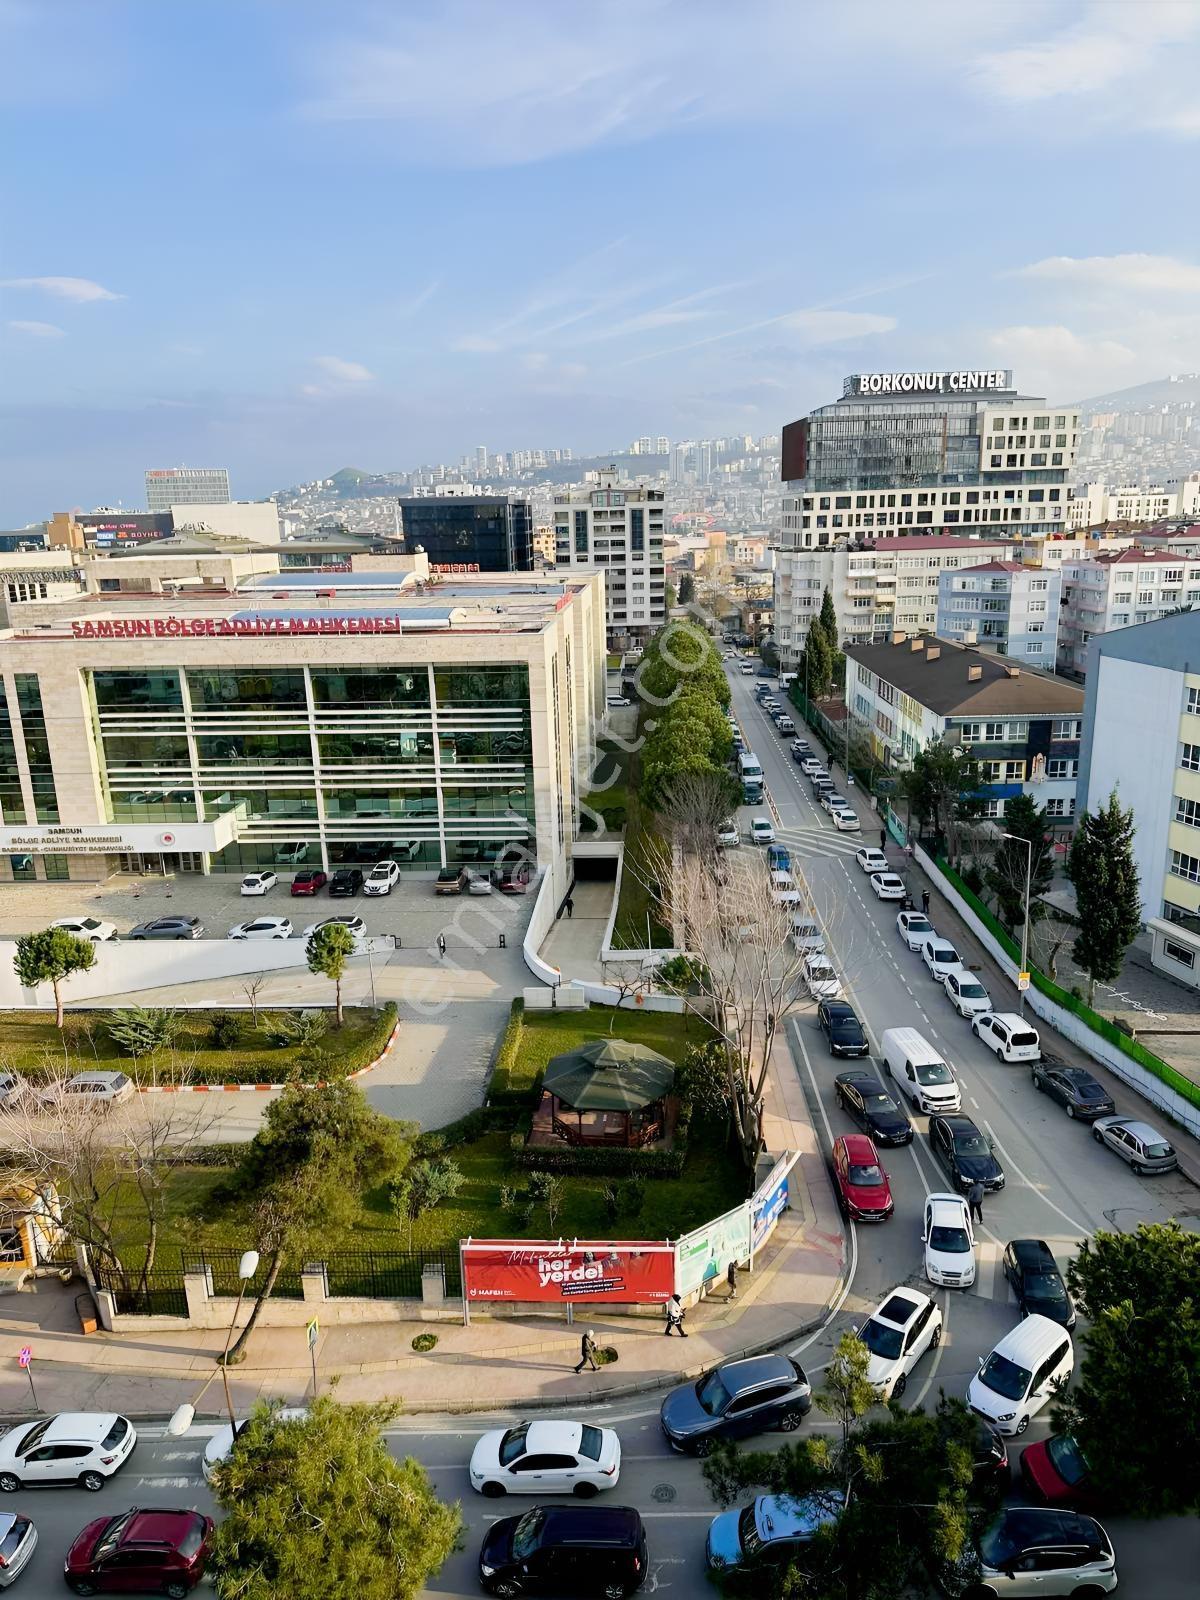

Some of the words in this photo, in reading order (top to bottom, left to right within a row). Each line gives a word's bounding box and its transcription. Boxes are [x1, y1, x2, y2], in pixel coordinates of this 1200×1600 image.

[860, 373, 946, 392] BORKONUT
[950, 370, 1005, 389] CENTER
[72, 620, 150, 637] SAMSUN
[154, 616, 215, 636] BÖLGE
[220, 614, 285, 633] ADLİYE
[289, 613, 400, 632] MAHKEMESİ
[538, 1258, 572, 1272] her
[539, 1264, 604, 1288] yerde!
